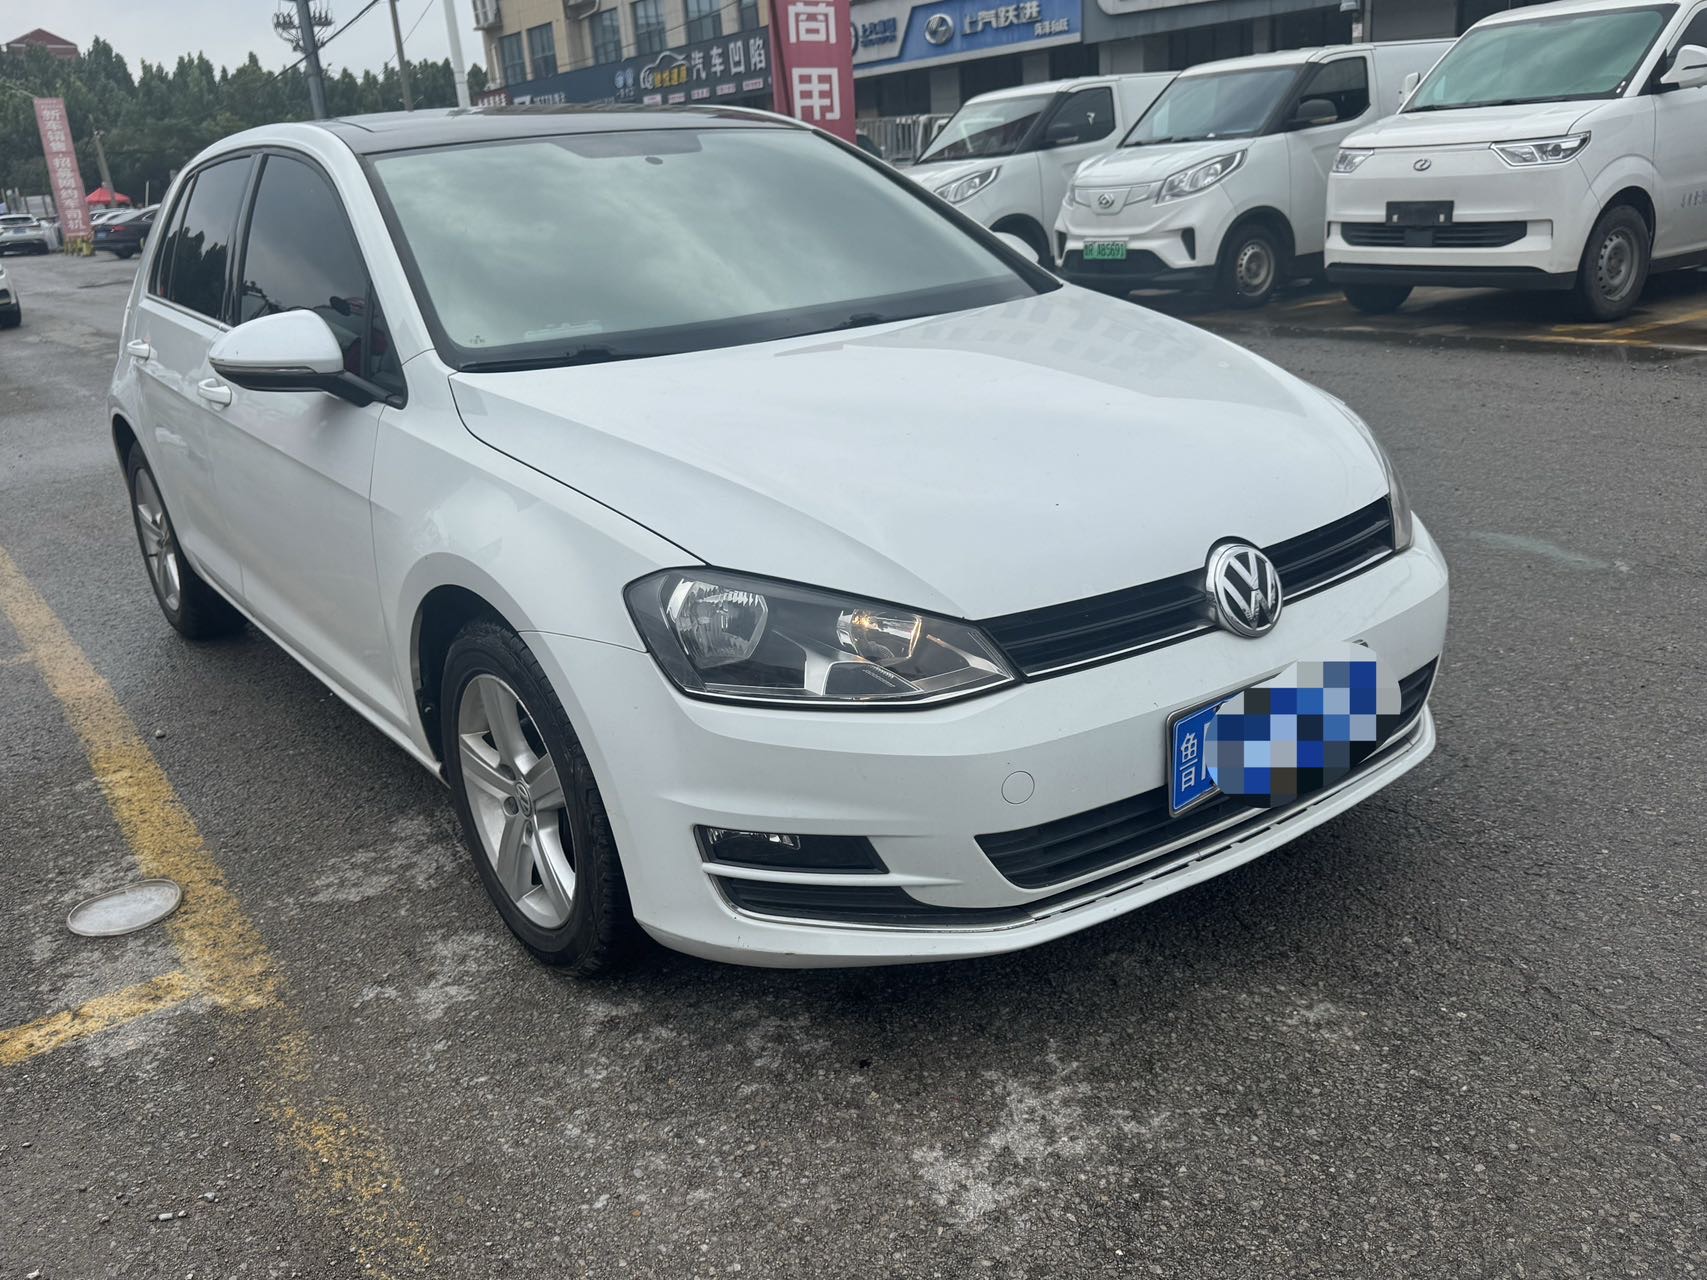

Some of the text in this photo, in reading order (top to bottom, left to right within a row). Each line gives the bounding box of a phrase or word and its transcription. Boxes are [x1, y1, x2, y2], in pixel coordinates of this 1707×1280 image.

[962, 0, 1041, 35] 上汽跃进
[691, 36, 766, 81] 汽车凹陷
[788, 0, 840, 120] 商用
